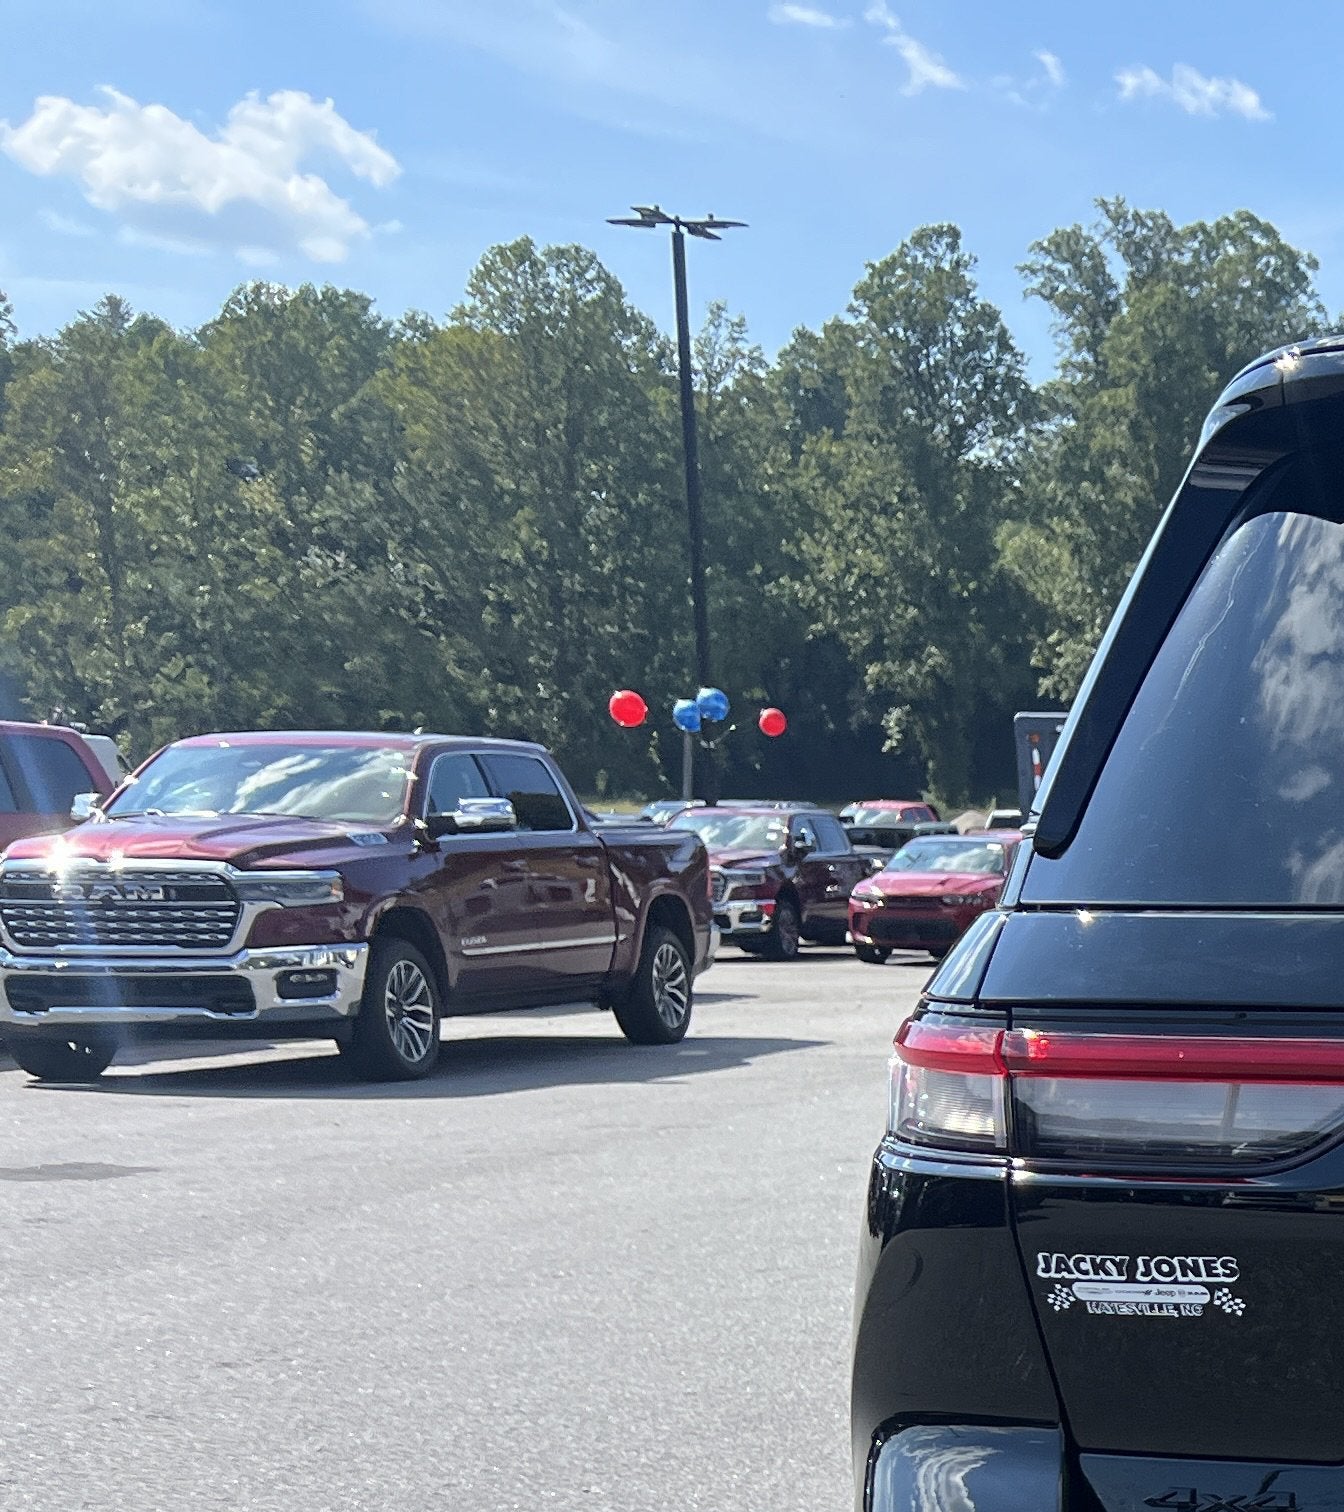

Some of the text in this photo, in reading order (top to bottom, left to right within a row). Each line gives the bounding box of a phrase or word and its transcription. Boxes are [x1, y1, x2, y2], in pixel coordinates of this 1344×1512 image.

[51, 884, 165, 901] RAM
[1036, 1252, 1241, 1282] JACKY JONES
